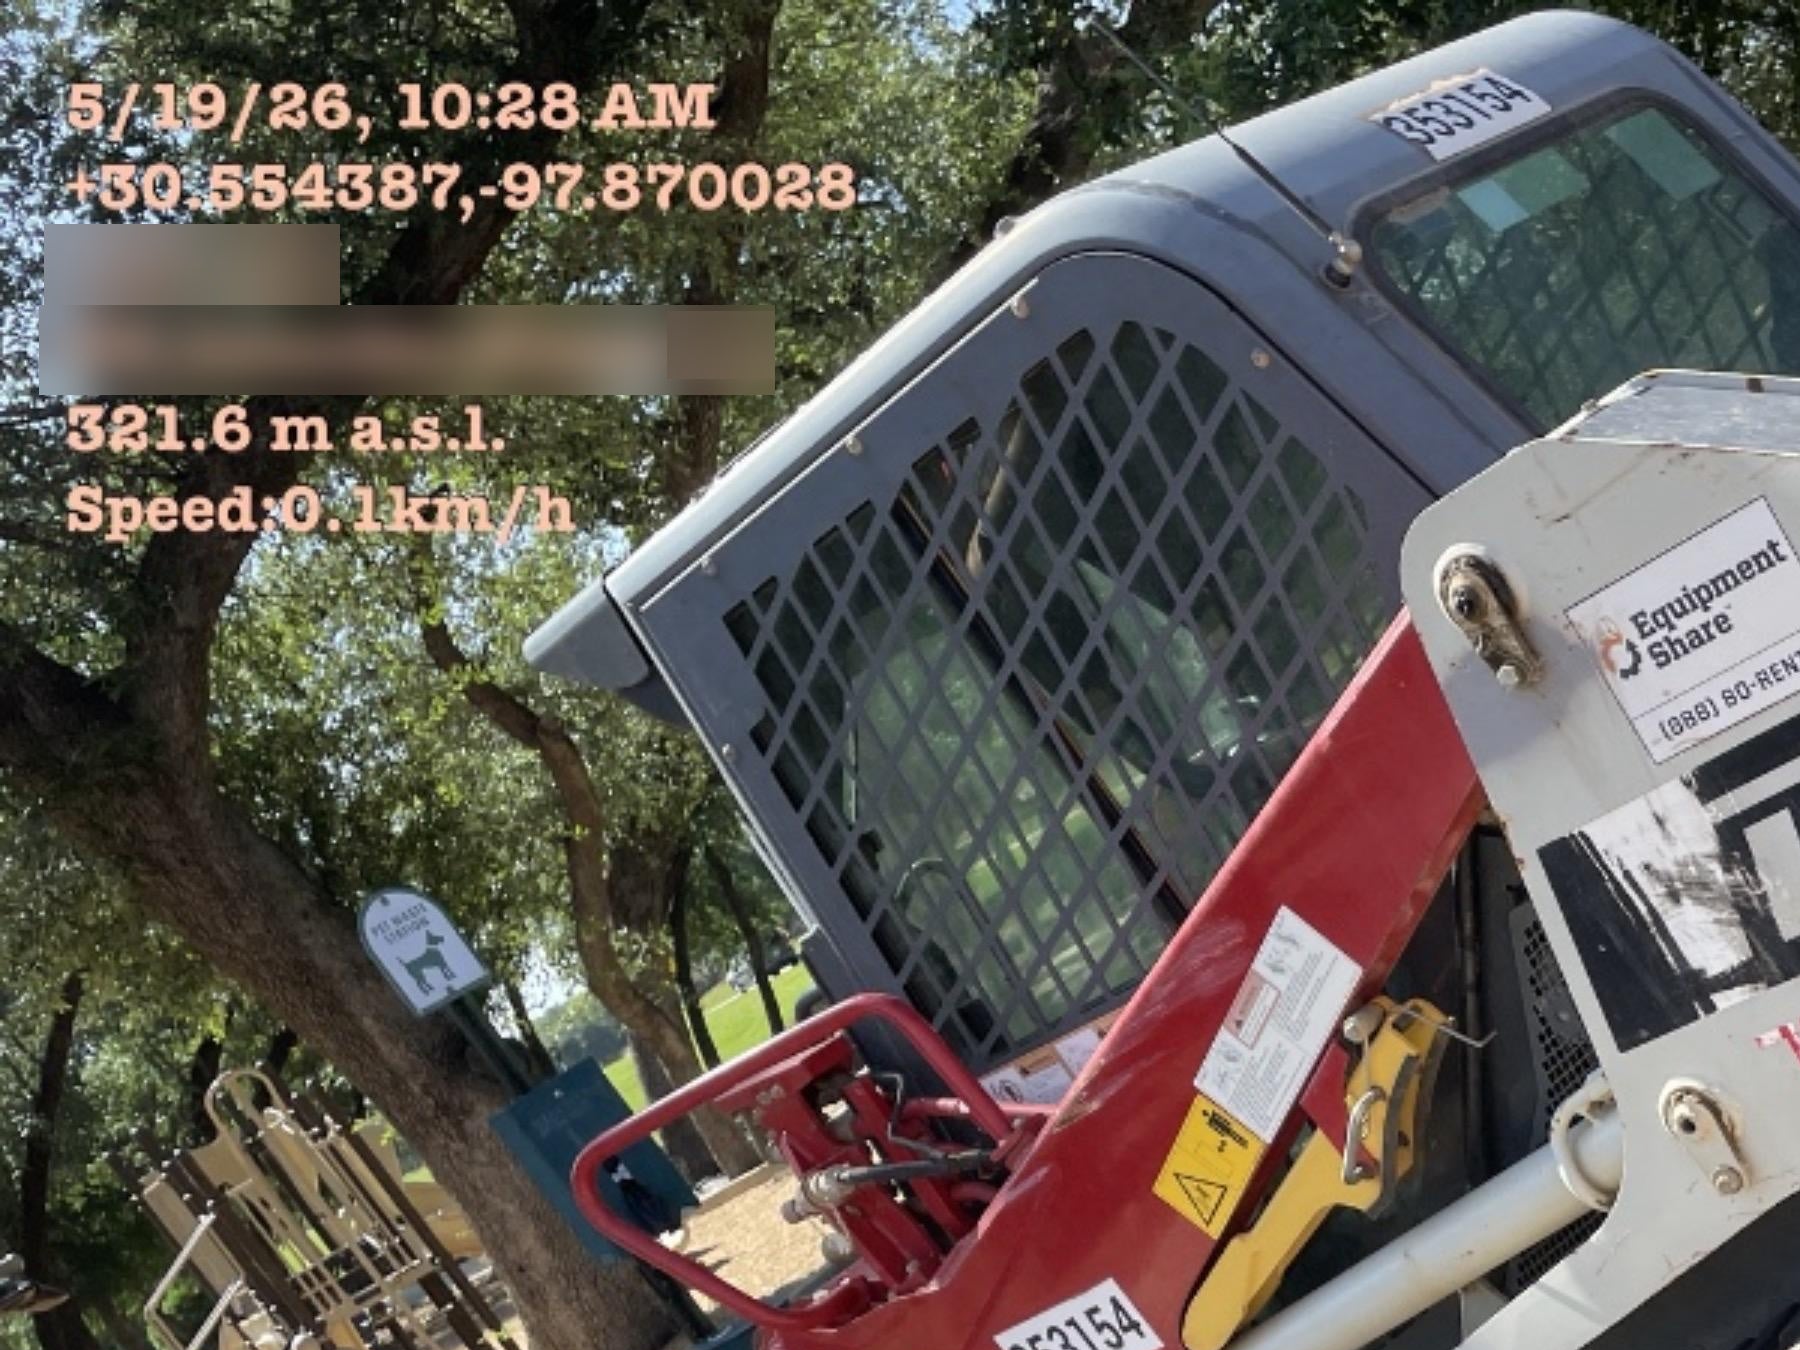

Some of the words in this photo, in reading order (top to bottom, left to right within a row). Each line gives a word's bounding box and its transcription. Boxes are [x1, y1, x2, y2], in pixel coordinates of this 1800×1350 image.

[1383, 76, 1531, 146] 353154
[1629, 538, 1787, 640] Equipment
[1647, 611, 1734, 670] Share
